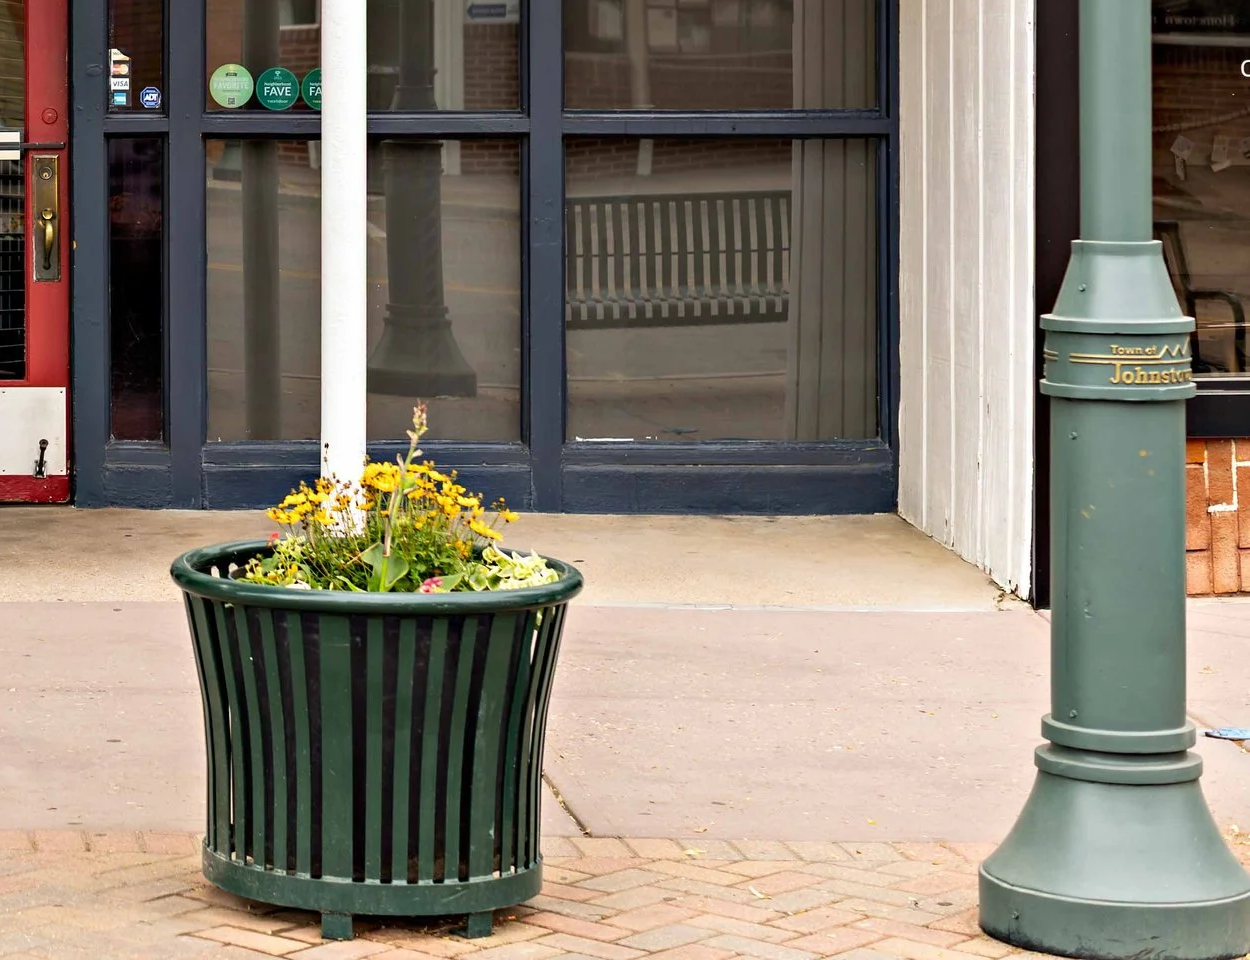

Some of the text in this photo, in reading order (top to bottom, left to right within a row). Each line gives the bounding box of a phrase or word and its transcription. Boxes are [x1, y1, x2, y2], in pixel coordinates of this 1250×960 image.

[264, 86, 292, 96] FAVE
[309, 86, 322, 96] FA
[144, 93, 158, 101] ADT
[1110, 344, 1158, 355] Town of
